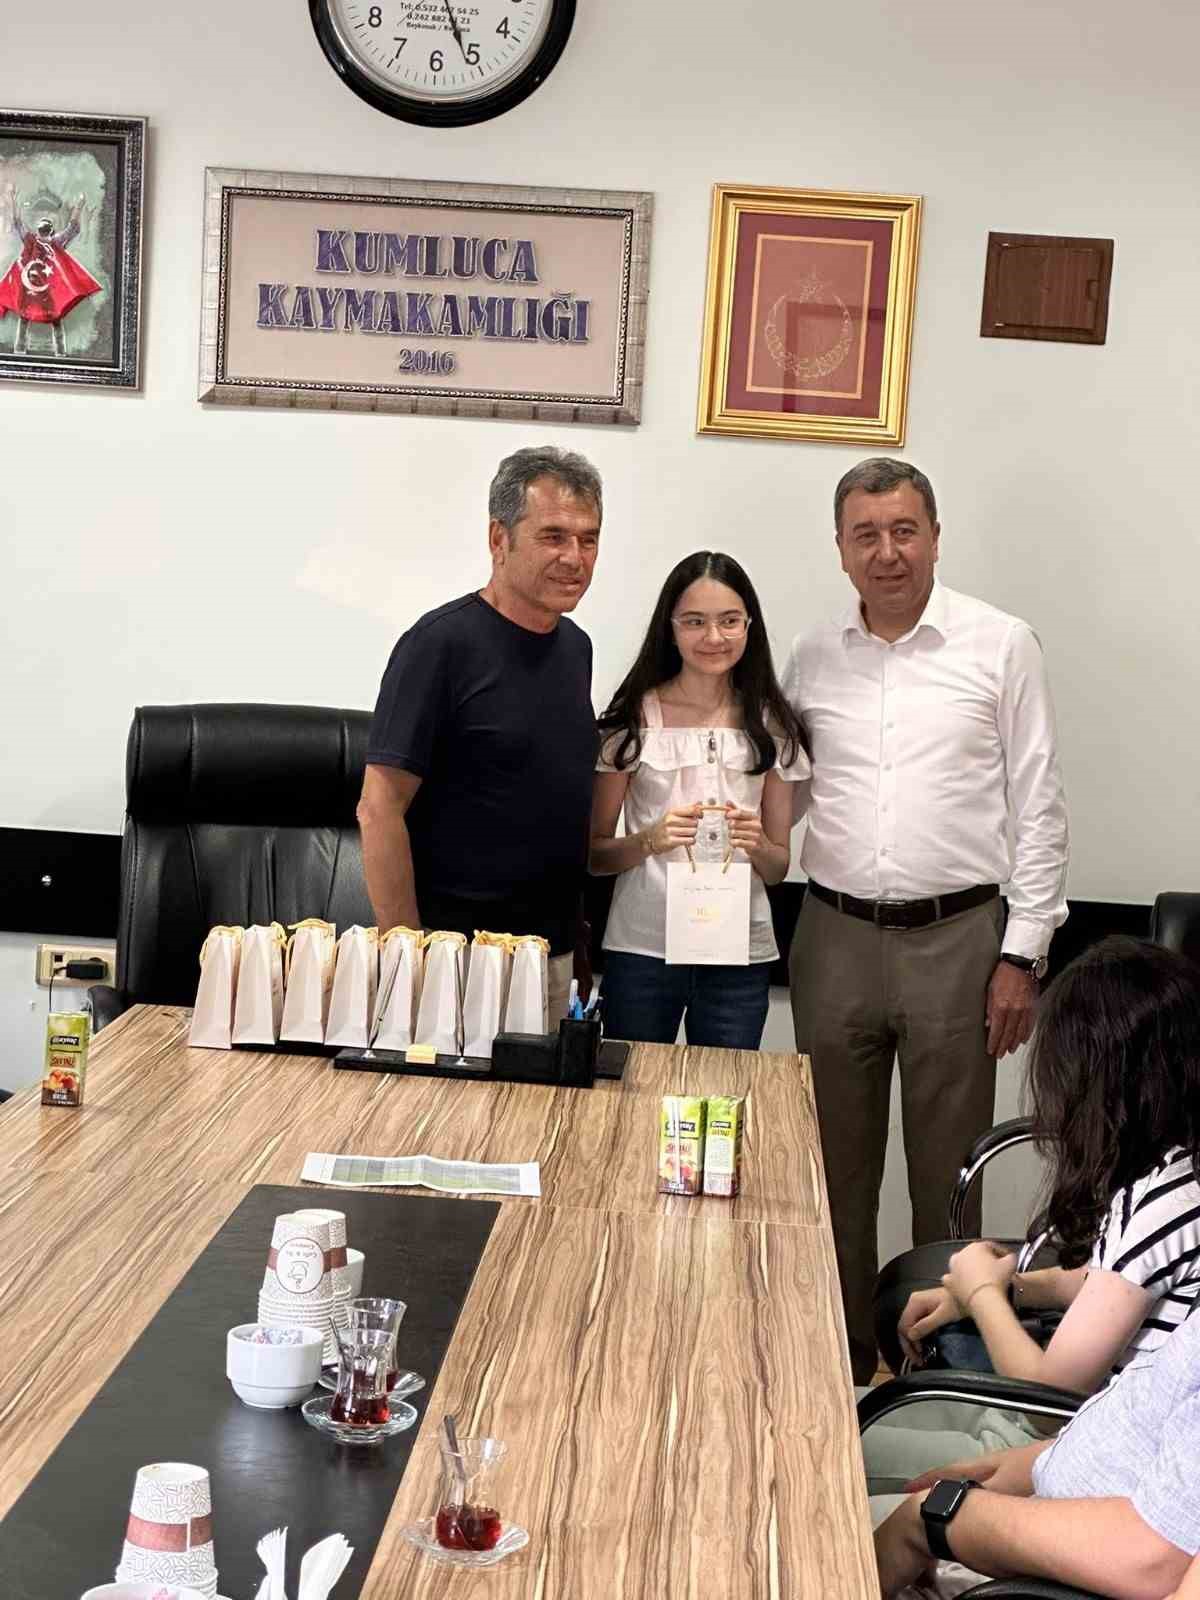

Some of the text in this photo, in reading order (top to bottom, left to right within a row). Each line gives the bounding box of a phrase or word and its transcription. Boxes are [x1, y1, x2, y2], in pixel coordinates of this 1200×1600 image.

[368, 6, 382, 28] 8
[496, 17, 510, 39] 4
[393, 37, 408, 59] 7
[466, 43, 481, 65] 5
[429, 50, 444, 72] 6
[314, 229, 540, 283] KUMLUCA
[256, 283, 593, 345] KAYMAKAMLIĞI
[398, 348, 457, 376] 2016
